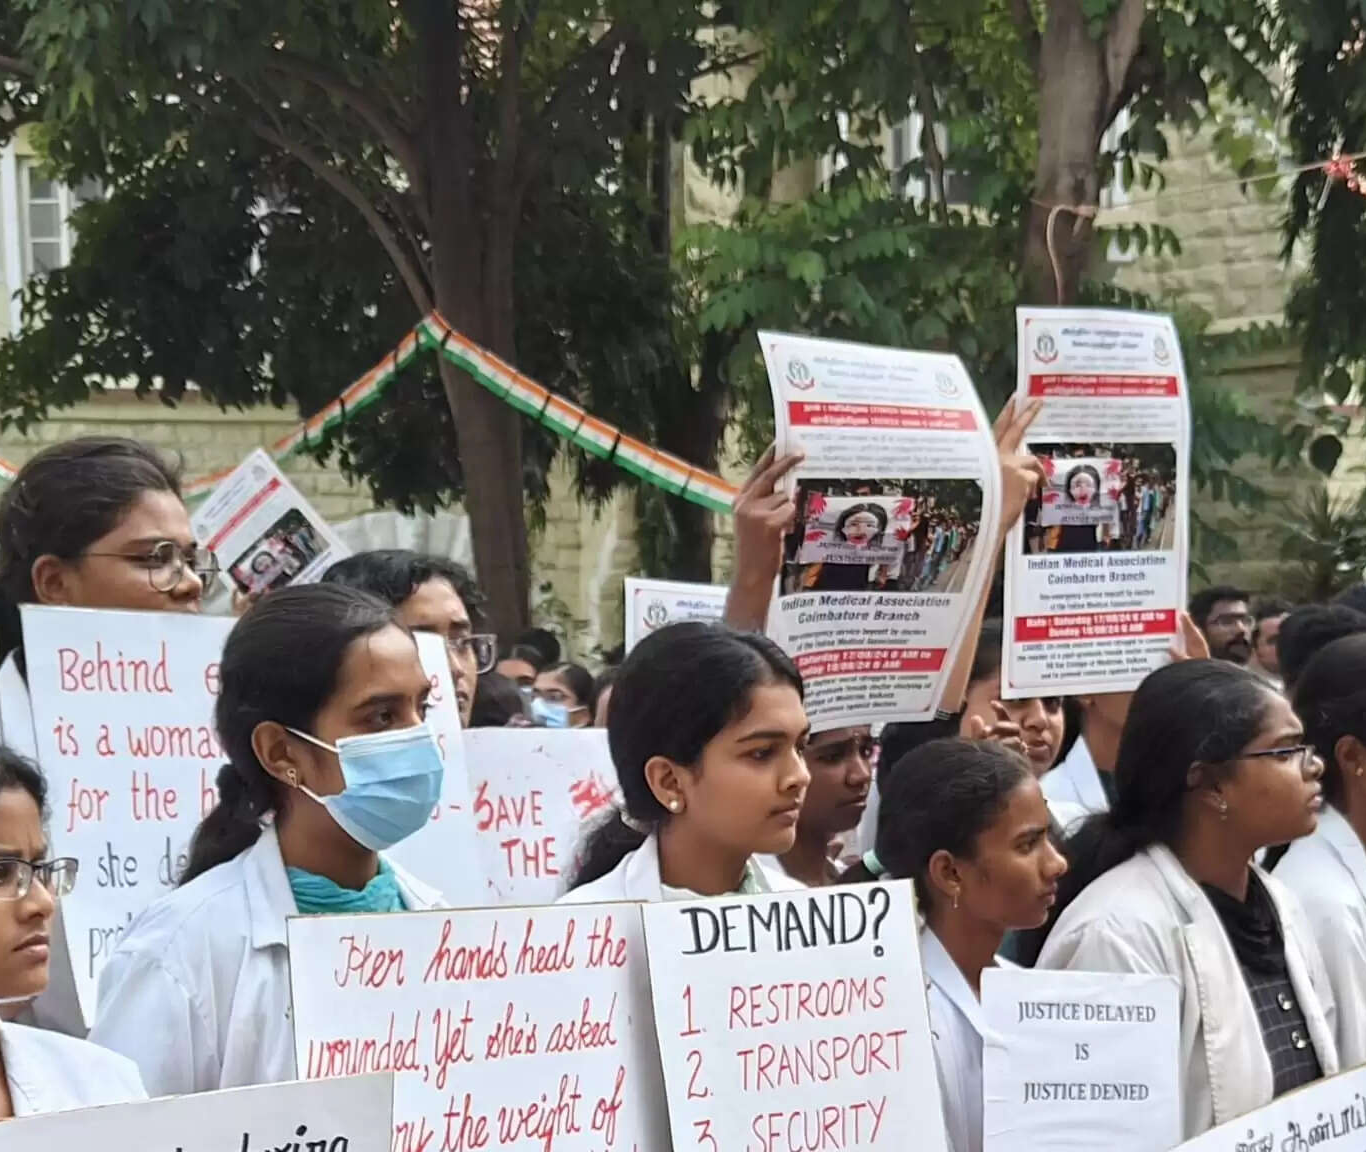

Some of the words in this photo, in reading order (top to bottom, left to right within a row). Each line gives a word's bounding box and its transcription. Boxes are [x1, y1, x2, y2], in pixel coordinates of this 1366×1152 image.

[1027, 558, 1060, 570] Indian
[1063, 556, 1104, 569] Medical
[1107, 554, 1167, 567] Association
[1047, 572, 1106, 585] Coimbatore
[1109, 571, 1146, 582] Branch
[781, 596, 815, 611] Indian
[818, 595, 871, 607] Medical
[874, 594, 951, 608] Association
[797, 610, 870, 624] Coimbatore
[873, 609, 920, 622] Branch
[58, 640, 173, 694] Behind
[53, 716, 79, 757] is
[96, 724, 115, 757] a
[67, 777, 110, 833] for
[131, 769, 179, 821] the
[473, 780, 543, 833] SAVE
[96, 840, 138, 888] she
[501, 837, 560, 878] THE
[680, 887, 891, 959] DEMAND?
[334, 934, 404, 988] Her
[424, 917, 510, 985] hands
[514, 915, 575, 976] heal
[586, 914, 627, 971] the
[484, 1002, 538, 1061] she's
[544, 991, 617, 1054] asked
[728, 976, 887, 1030] RESTROOMS
[1018, 1001, 1081, 1023] JUSTICE
[1083, 1002, 1156, 1023] DELAYED
[686, 1049, 714, 1100] 2.
[737, 1029, 908, 1092] TRANSPORT
[1074, 1043, 1090, 1062] IS
[591, 1064, 626, 1148] of
[1023, 1082, 1088, 1103] JUSTICE
[1090, 1082, 1150, 1102] DENIED
